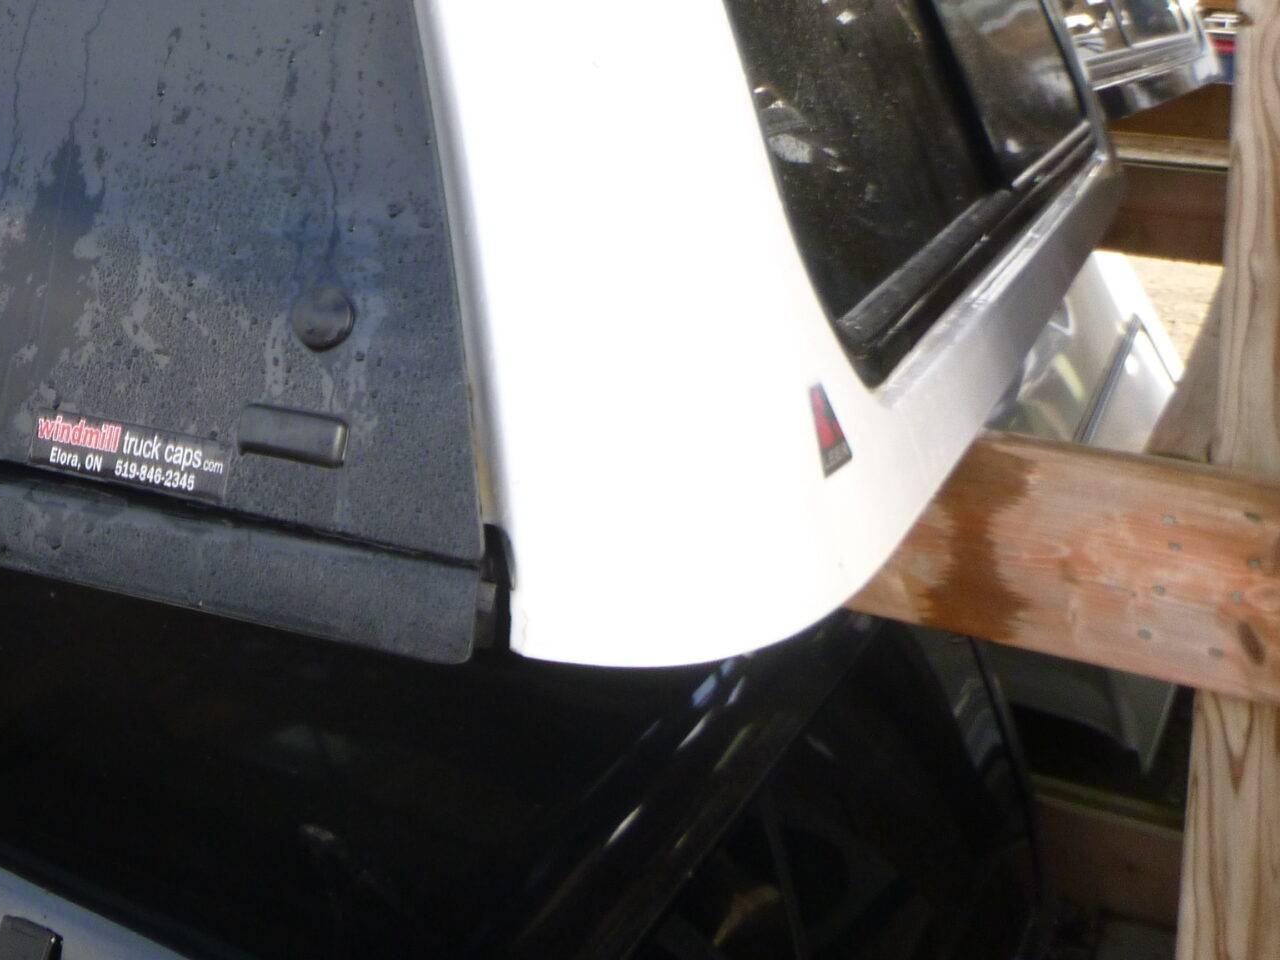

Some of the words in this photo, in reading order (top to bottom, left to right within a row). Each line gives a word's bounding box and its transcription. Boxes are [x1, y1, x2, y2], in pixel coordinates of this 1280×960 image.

[37, 414, 122, 453] windmill
[122, 431, 161, 460] truck
[49, 446, 81, 471] Elora,
[84, 453, 103, 472] ON
[114, 459, 195, 491] 519-846-2345
